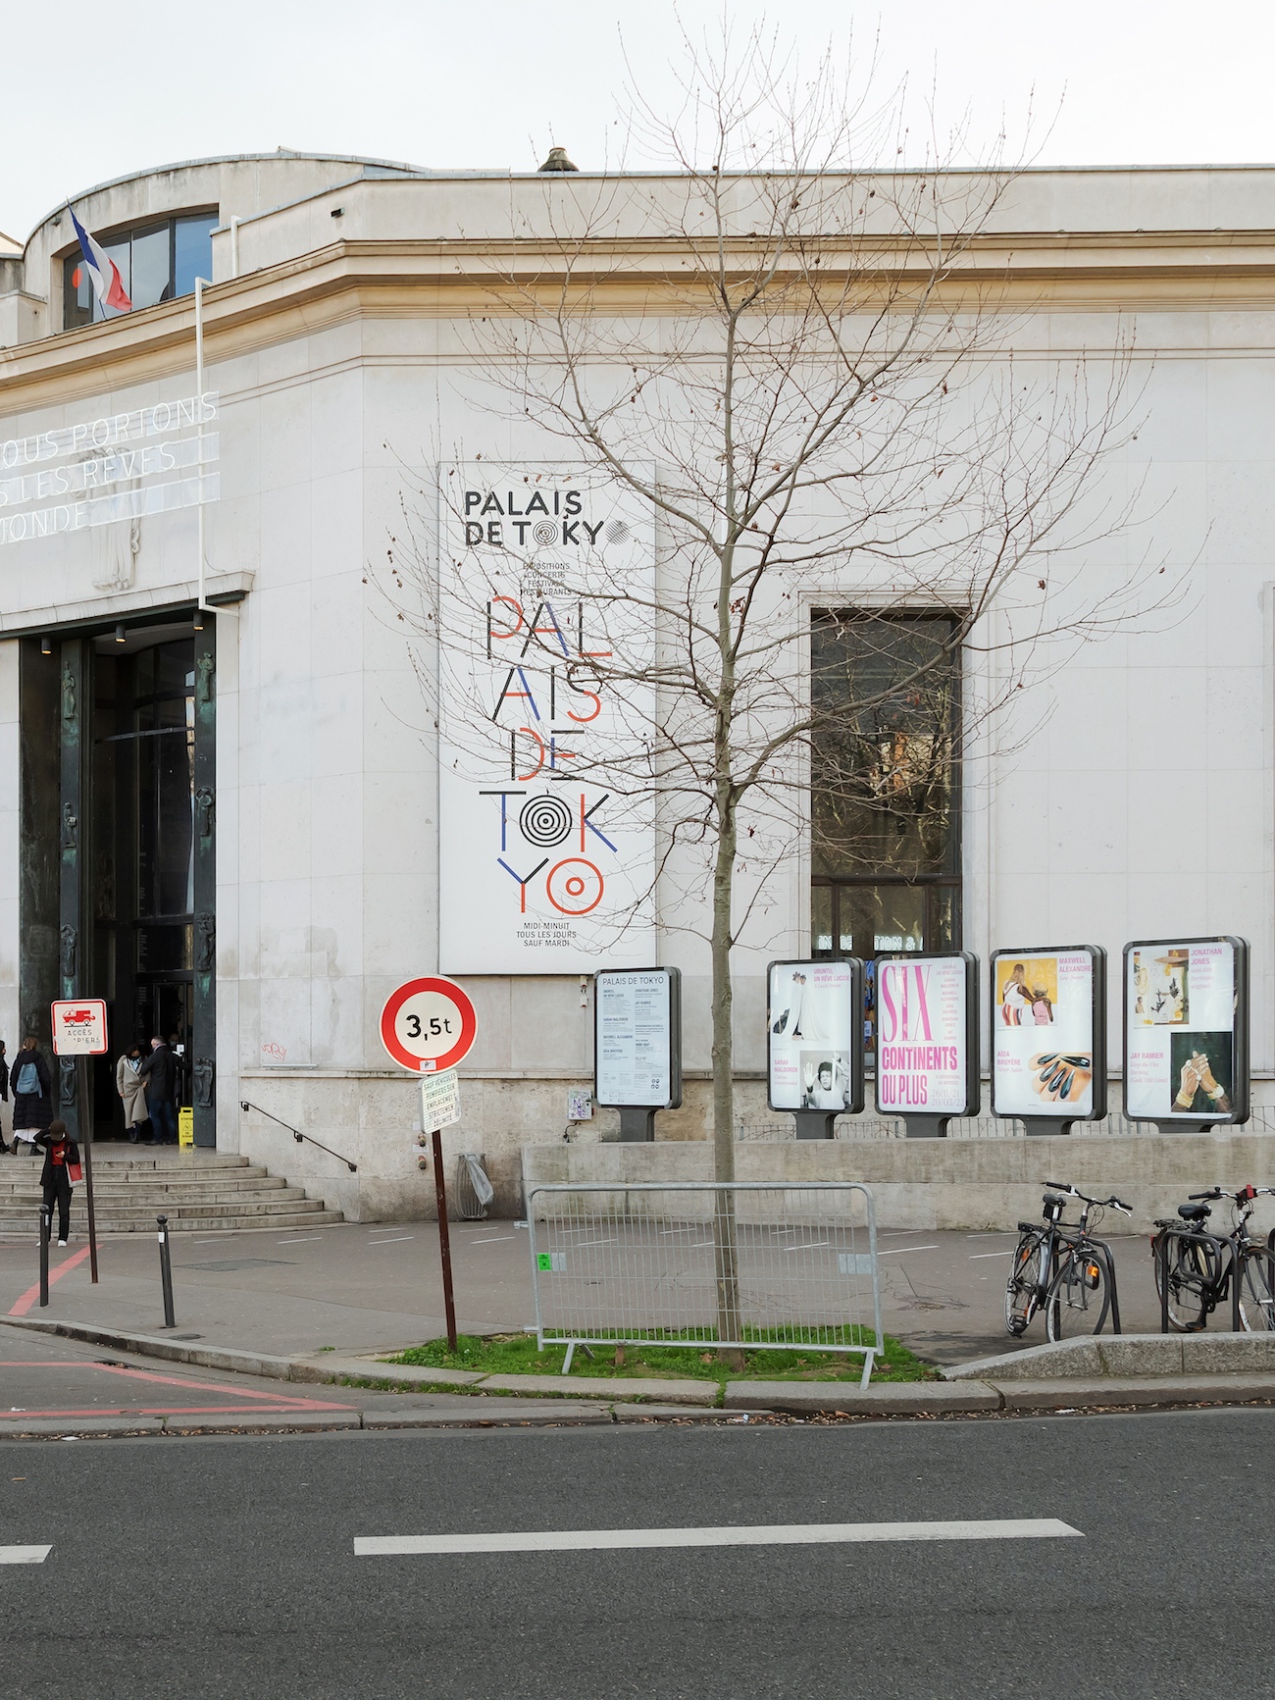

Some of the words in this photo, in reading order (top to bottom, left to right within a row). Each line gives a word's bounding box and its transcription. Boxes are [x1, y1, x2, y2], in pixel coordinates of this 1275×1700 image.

[73, 391, 217, 450] PORTONS
[22, 466, 68, 501] LES
[83, 441, 176, 486] RÊVES
[465, 490, 583, 517] PALAIS
[465, 521, 503, 546] DE
[486, 596, 613, 660] PAL
[492, 665, 601, 723] AIS
[510, 727, 585, 782] DE
[479, 790, 618, 853] TOK
[497, 857, 605, 915] YO
[516, 931, 536, 939] TOUS
[537, 931, 551, 939] LES
[553, 931, 577, 939] JOURS
[523, 922, 570, 930] MIDI-MINUIT
[1190, 948, 1223, 957] JONATHAN
[1190, 957, 1211, 965] JONES
[602, 977, 627, 985] PALAIS
[628, 977, 638, 985] DE
[639, 976, 664, 984] TOKYO
[1058, 964, 1092, 973] ALEXANDRE
[881, 964, 934, 1043] SIX
[67, 1028, 92, 1036] ACCÈS
[882, 1045, 958, 1071] CONTINENTS
[882, 1074, 896, 1105] OU
[898, 1074, 928, 1105] PLUS
